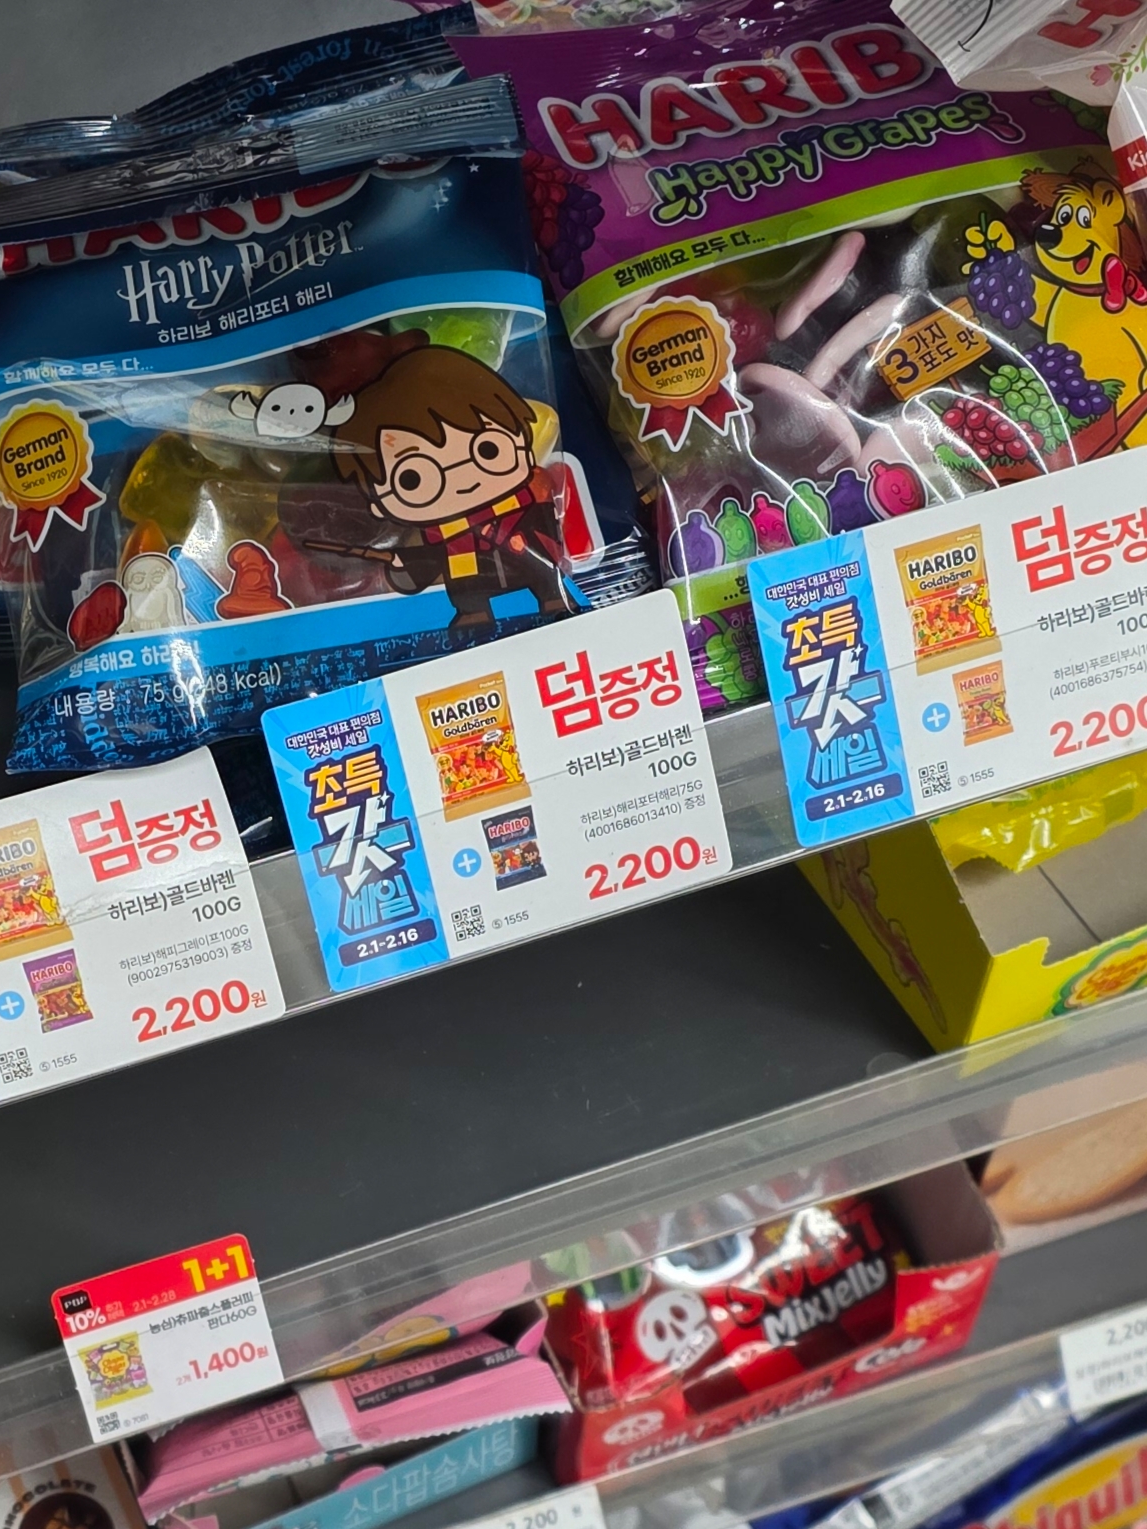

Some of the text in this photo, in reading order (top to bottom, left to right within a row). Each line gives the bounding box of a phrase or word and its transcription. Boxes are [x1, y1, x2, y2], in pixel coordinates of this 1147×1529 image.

[657, 94, 991, 204] Happy Grapes
[117, 219, 353, 325] Harry Potter
[613, 247, 689, 290] 함께해요
[693, 236, 729, 263] 모두
[157, 282, 334, 345] 하리보 해리포터 해리
[631, 323, 708, 367] German
[907, 321, 947, 354] 가지
[919, 327, 979, 373] 포도 맛
[81, 360, 118, 379] 모두
[646, 344, 706, 381] Brand
[655, 366, 707, 389] Since 1920
[885, 348, 919, 384] 3
[3, 425, 69, 466] German
[13, 445, 67, 481] Brand
[21, 466, 69, 494] Since 1920
[908, 545, 977, 579] HARIBO
[919, 568, 973, 591] Goldbären
[766, 579, 807, 600] 대한민국
[807, 573, 828, 589] 대표
[828, 562, 861, 583] 편의점
[786, 581, 846, 610] 갓성비 세일
[786, 603, 859, 666] 초특
[54, 687, 117, 719] 내용량
[139, 682, 166, 705] 75
[234, 662, 282, 692] kcal)
[534, 649, 684, 739] 덤증정
[959, 671, 999, 692] HARIBO
[430, 692, 501, 728] HARIBO
[443, 714, 498, 738] Goldbären
[287, 711, 382, 749] 대한민국 대표 편의점
[306, 730, 369, 759] 갓성비 세일
[566, 724, 694, 778] 하리보)골드바렌
[647, 751, 698, 778] 100G
[309, 750, 383, 814] 초특
[970, 767, 995, 783] 1555
[580, 779, 704, 826] 하리보)해리포터해리75G
[823, 782, 886, 812] 2.1-2.16
[488, 817, 530, 838] HARIBO
[584, 793, 706, 842] (4001686013410) 증정
[68, 799, 223, 883] 덤증정
[584, 836, 719, 901] 2,200원
[107, 868, 237, 921] 하리보)골드바렌
[191, 895, 242, 923] 100G
[503, 910, 530, 926] 1555
[118, 924, 250, 972] 하리보)해피그레이프100G
[356, 928, 419, 958] 2.1-2.16
[31, 962, 74, 983] HARIBO
[127, 937, 253, 987] (9002975319003) 증정
[131, 980, 268, 1043] 2,200원
[51, 1055, 78, 1071] 1555
[182, 1245, 249, 1293] 1+1
[66, 1306, 107, 1334] 10%
[207, 1305, 258, 1331] 판다60G
[188, 1341, 269, 1381] 1,400원
